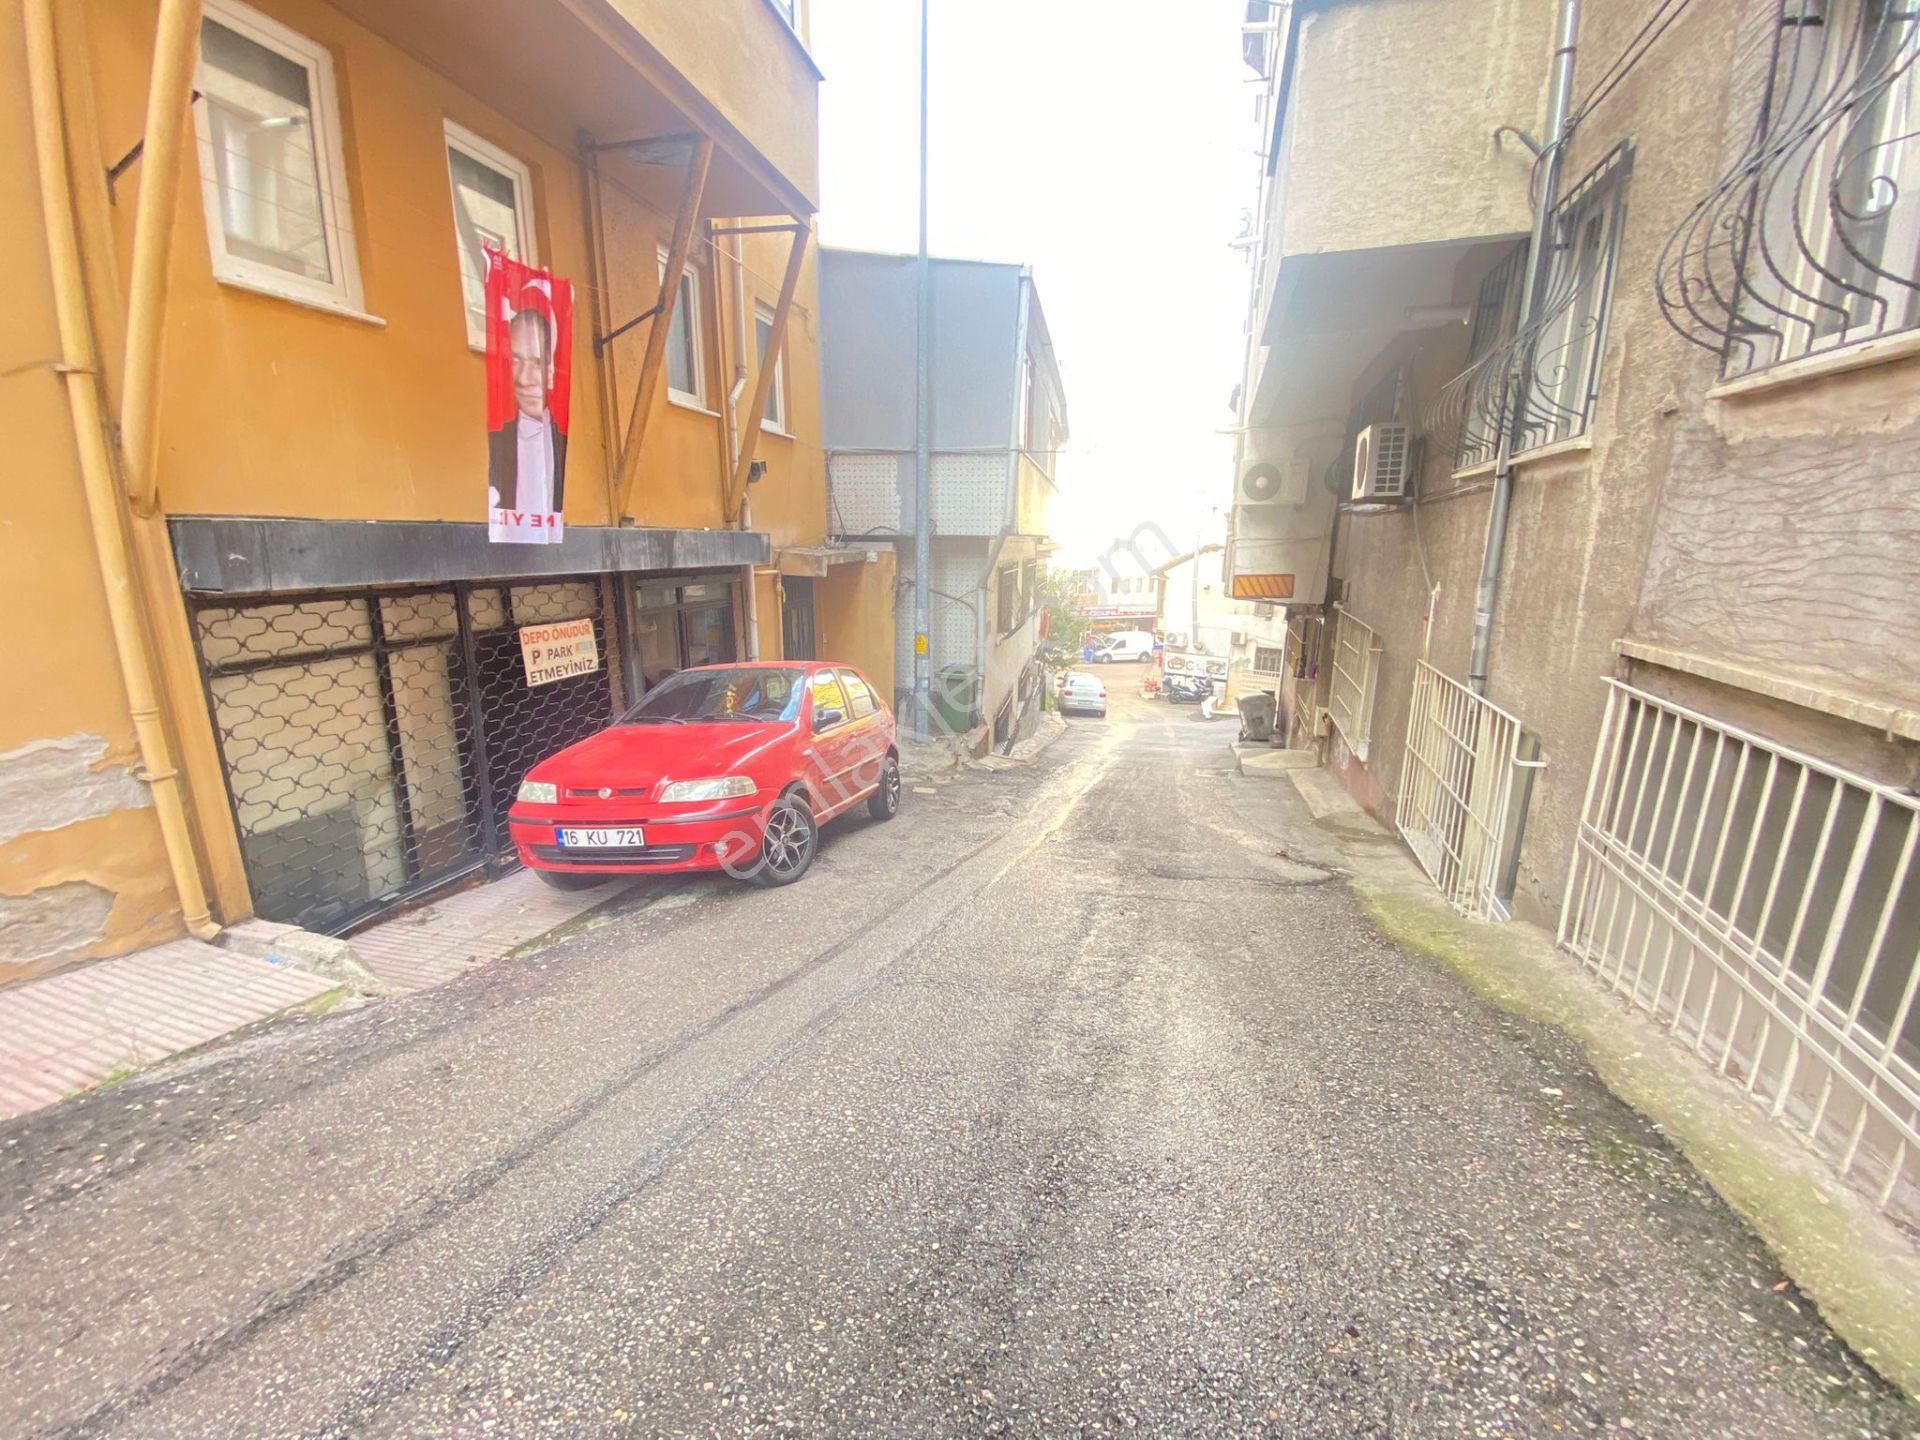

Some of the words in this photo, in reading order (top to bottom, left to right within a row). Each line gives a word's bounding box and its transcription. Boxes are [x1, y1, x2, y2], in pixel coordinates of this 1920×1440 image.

[522, 630, 550, 646] DEPO
[551, 622, 591, 642] ÖNÜDÜR
[547, 644, 573, 660] PARK
[564, 830, 579, 845] 16
[587, 831, 608, 845] KU
[616, 830, 643, 845] 721
